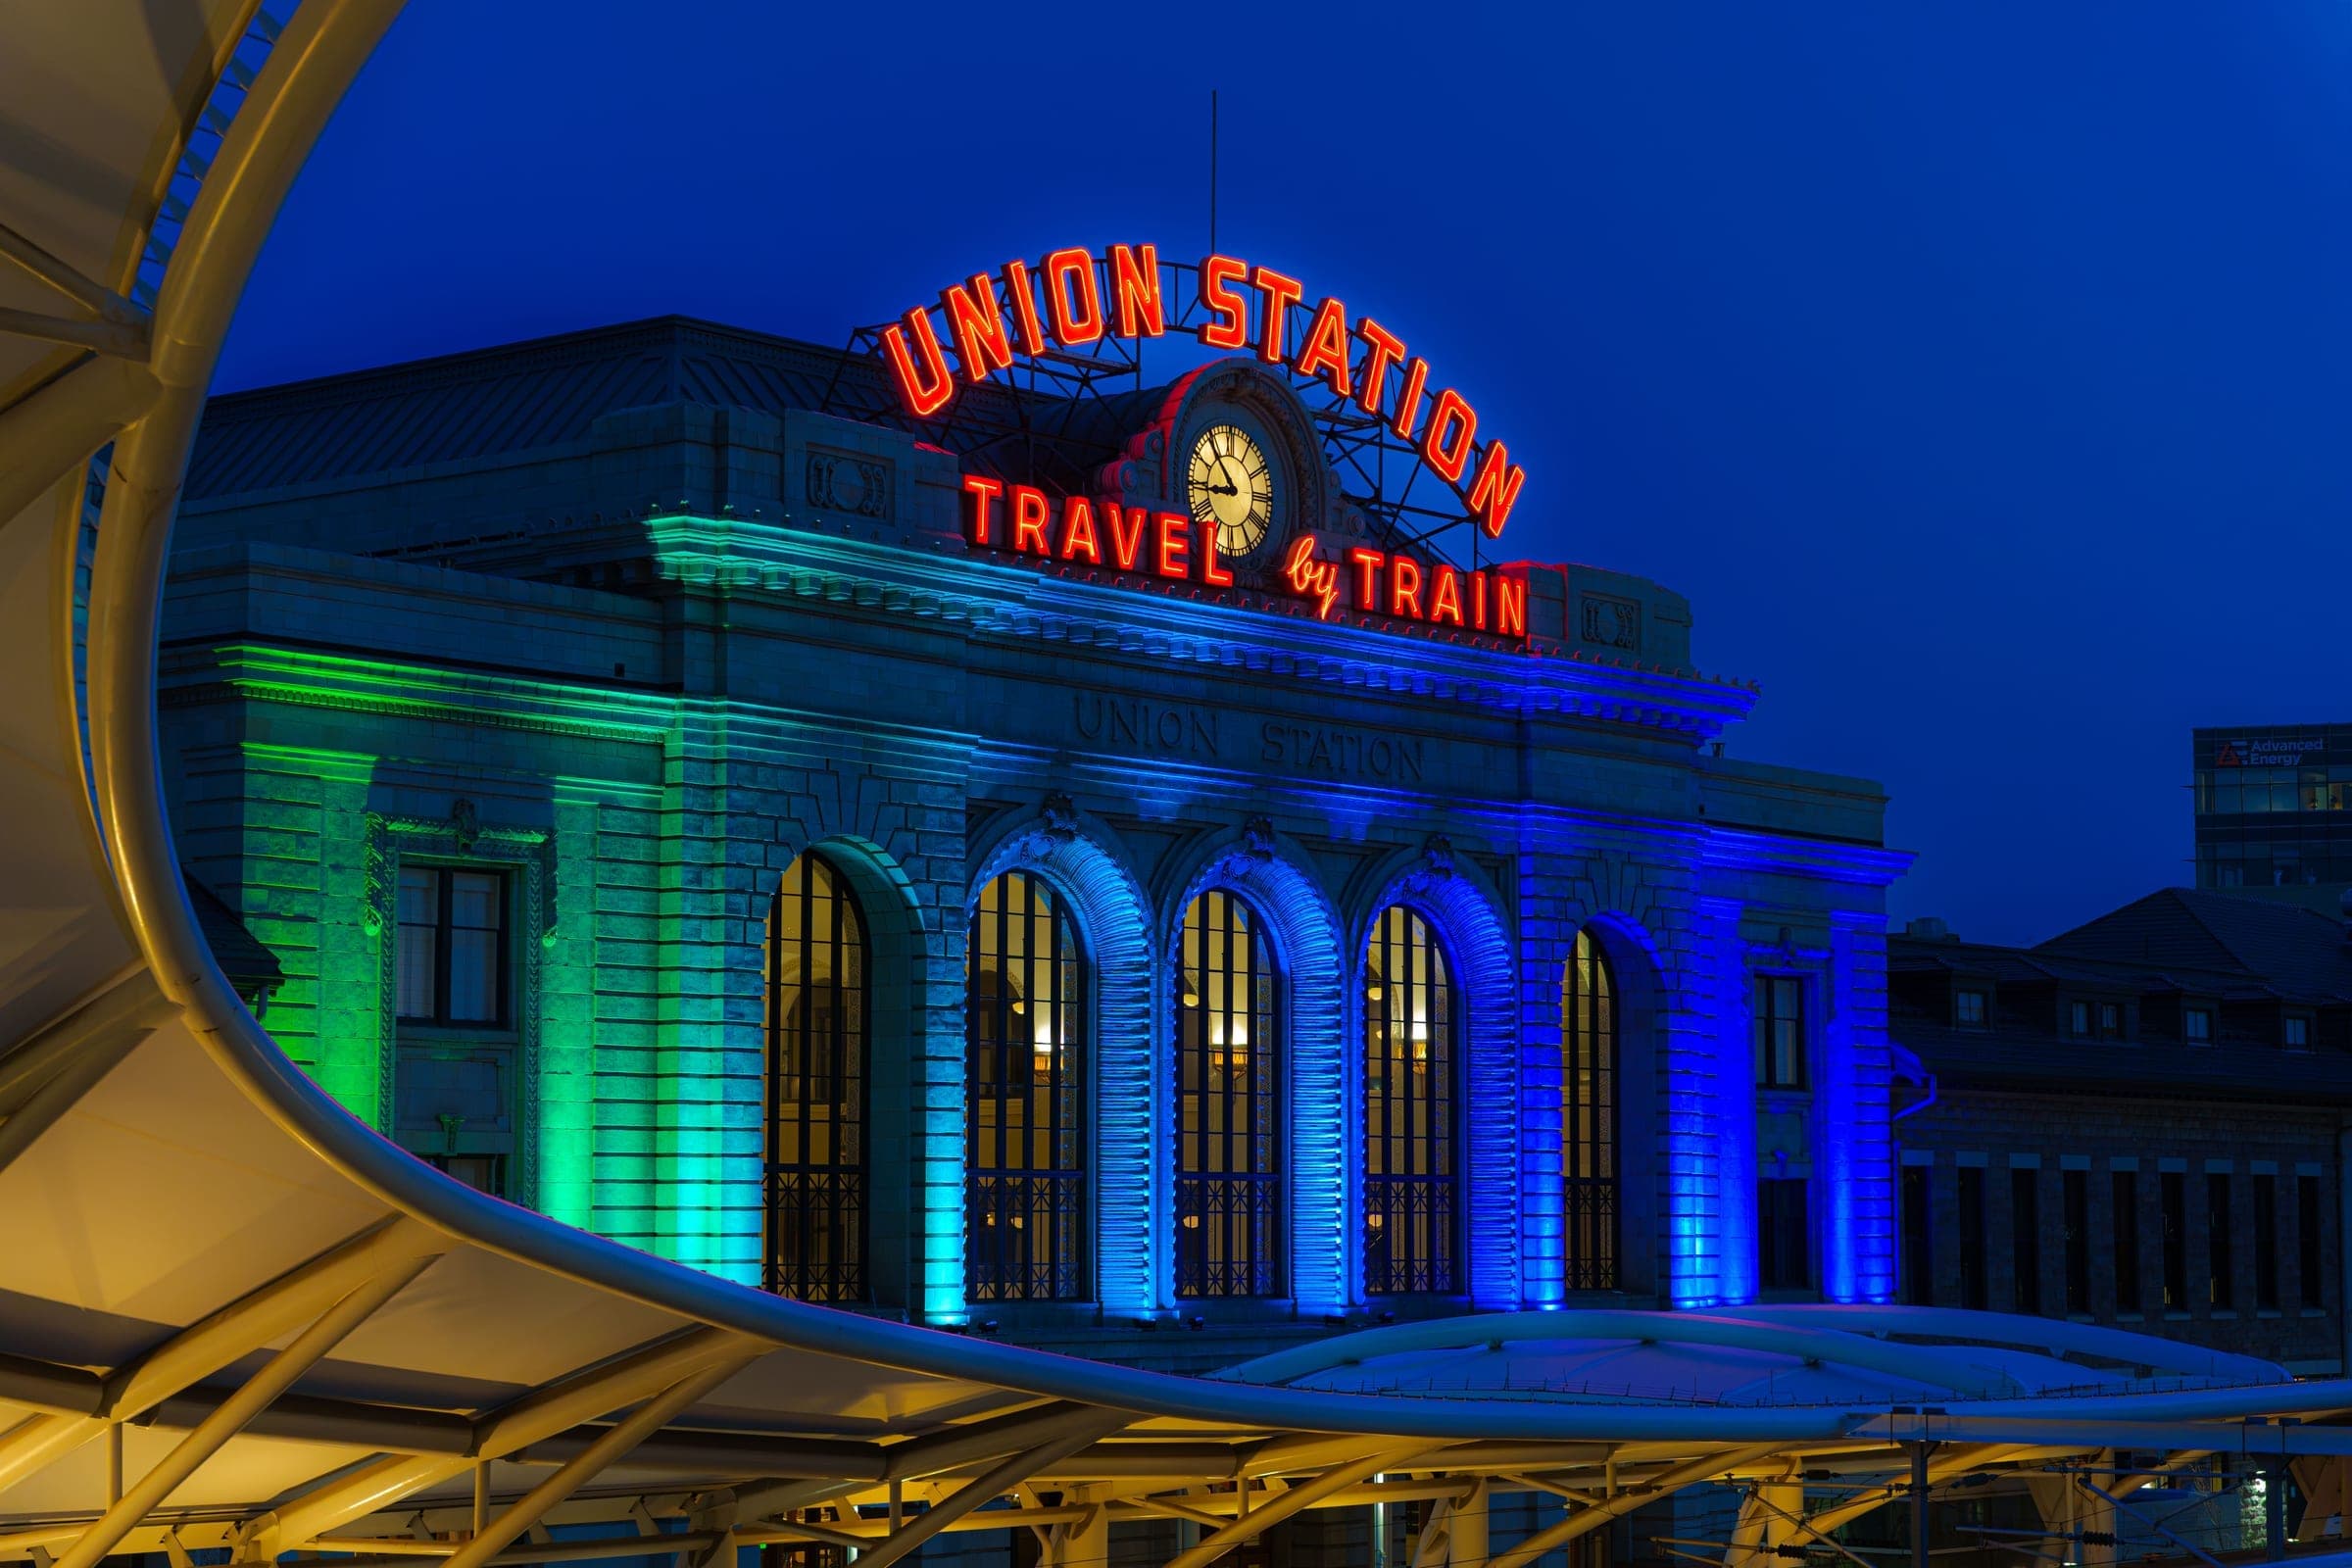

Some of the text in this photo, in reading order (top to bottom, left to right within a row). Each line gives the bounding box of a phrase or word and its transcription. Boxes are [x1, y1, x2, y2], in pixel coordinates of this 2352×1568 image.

[884, 243, 1526, 539] UNION STATION
[962, 474, 1527, 639] TRAVEL by TRAIN
[1074, 696, 1424, 781] UNION STATION
[2250, 753, 2302, 766] Energy
[2251, 738, 2324, 753] Advanced
